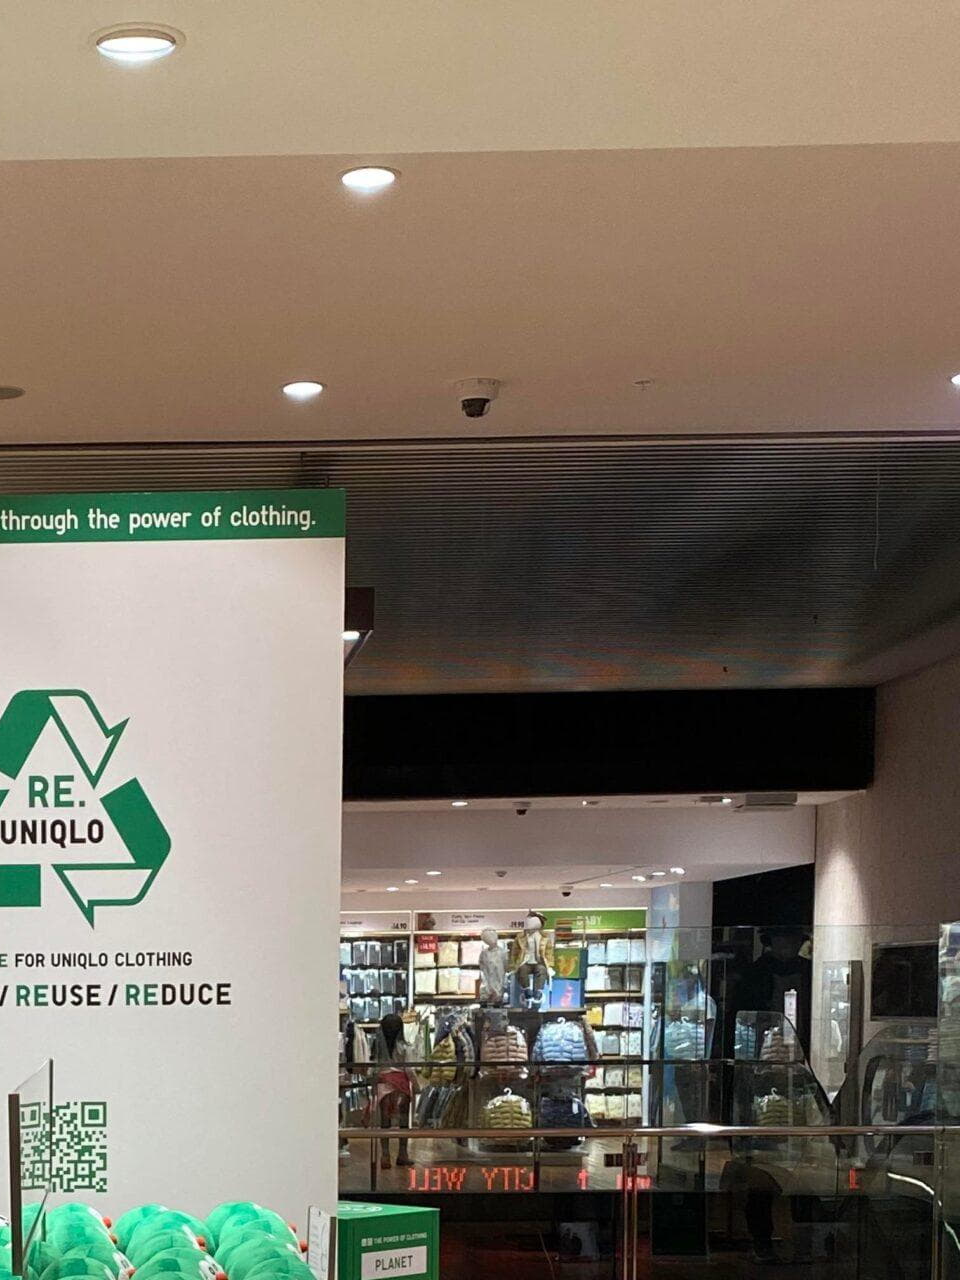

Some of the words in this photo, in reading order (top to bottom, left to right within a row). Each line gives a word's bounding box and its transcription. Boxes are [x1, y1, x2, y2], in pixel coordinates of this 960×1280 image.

[1, 511, 79, 535] through
[88, 510, 121, 530] the
[129, 511, 193, 533] power
[201, 506, 223, 528] of
[230, 505, 316, 532] clothing.
[28, 775, 86, 808] RE.
[0, 818, 104, 848] UNIQLO
[15, 953, 45, 967] FOR
[51, 952, 108, 969] UNIQLO
[115, 951, 193, 967] CLOTHING
[15, 984, 101, 1006] REUSE
[125, 983, 232, 1006] REDUCE
[383, 1235, 399, 1243] POWER
[375, 1255, 413, 1271] PLANET
